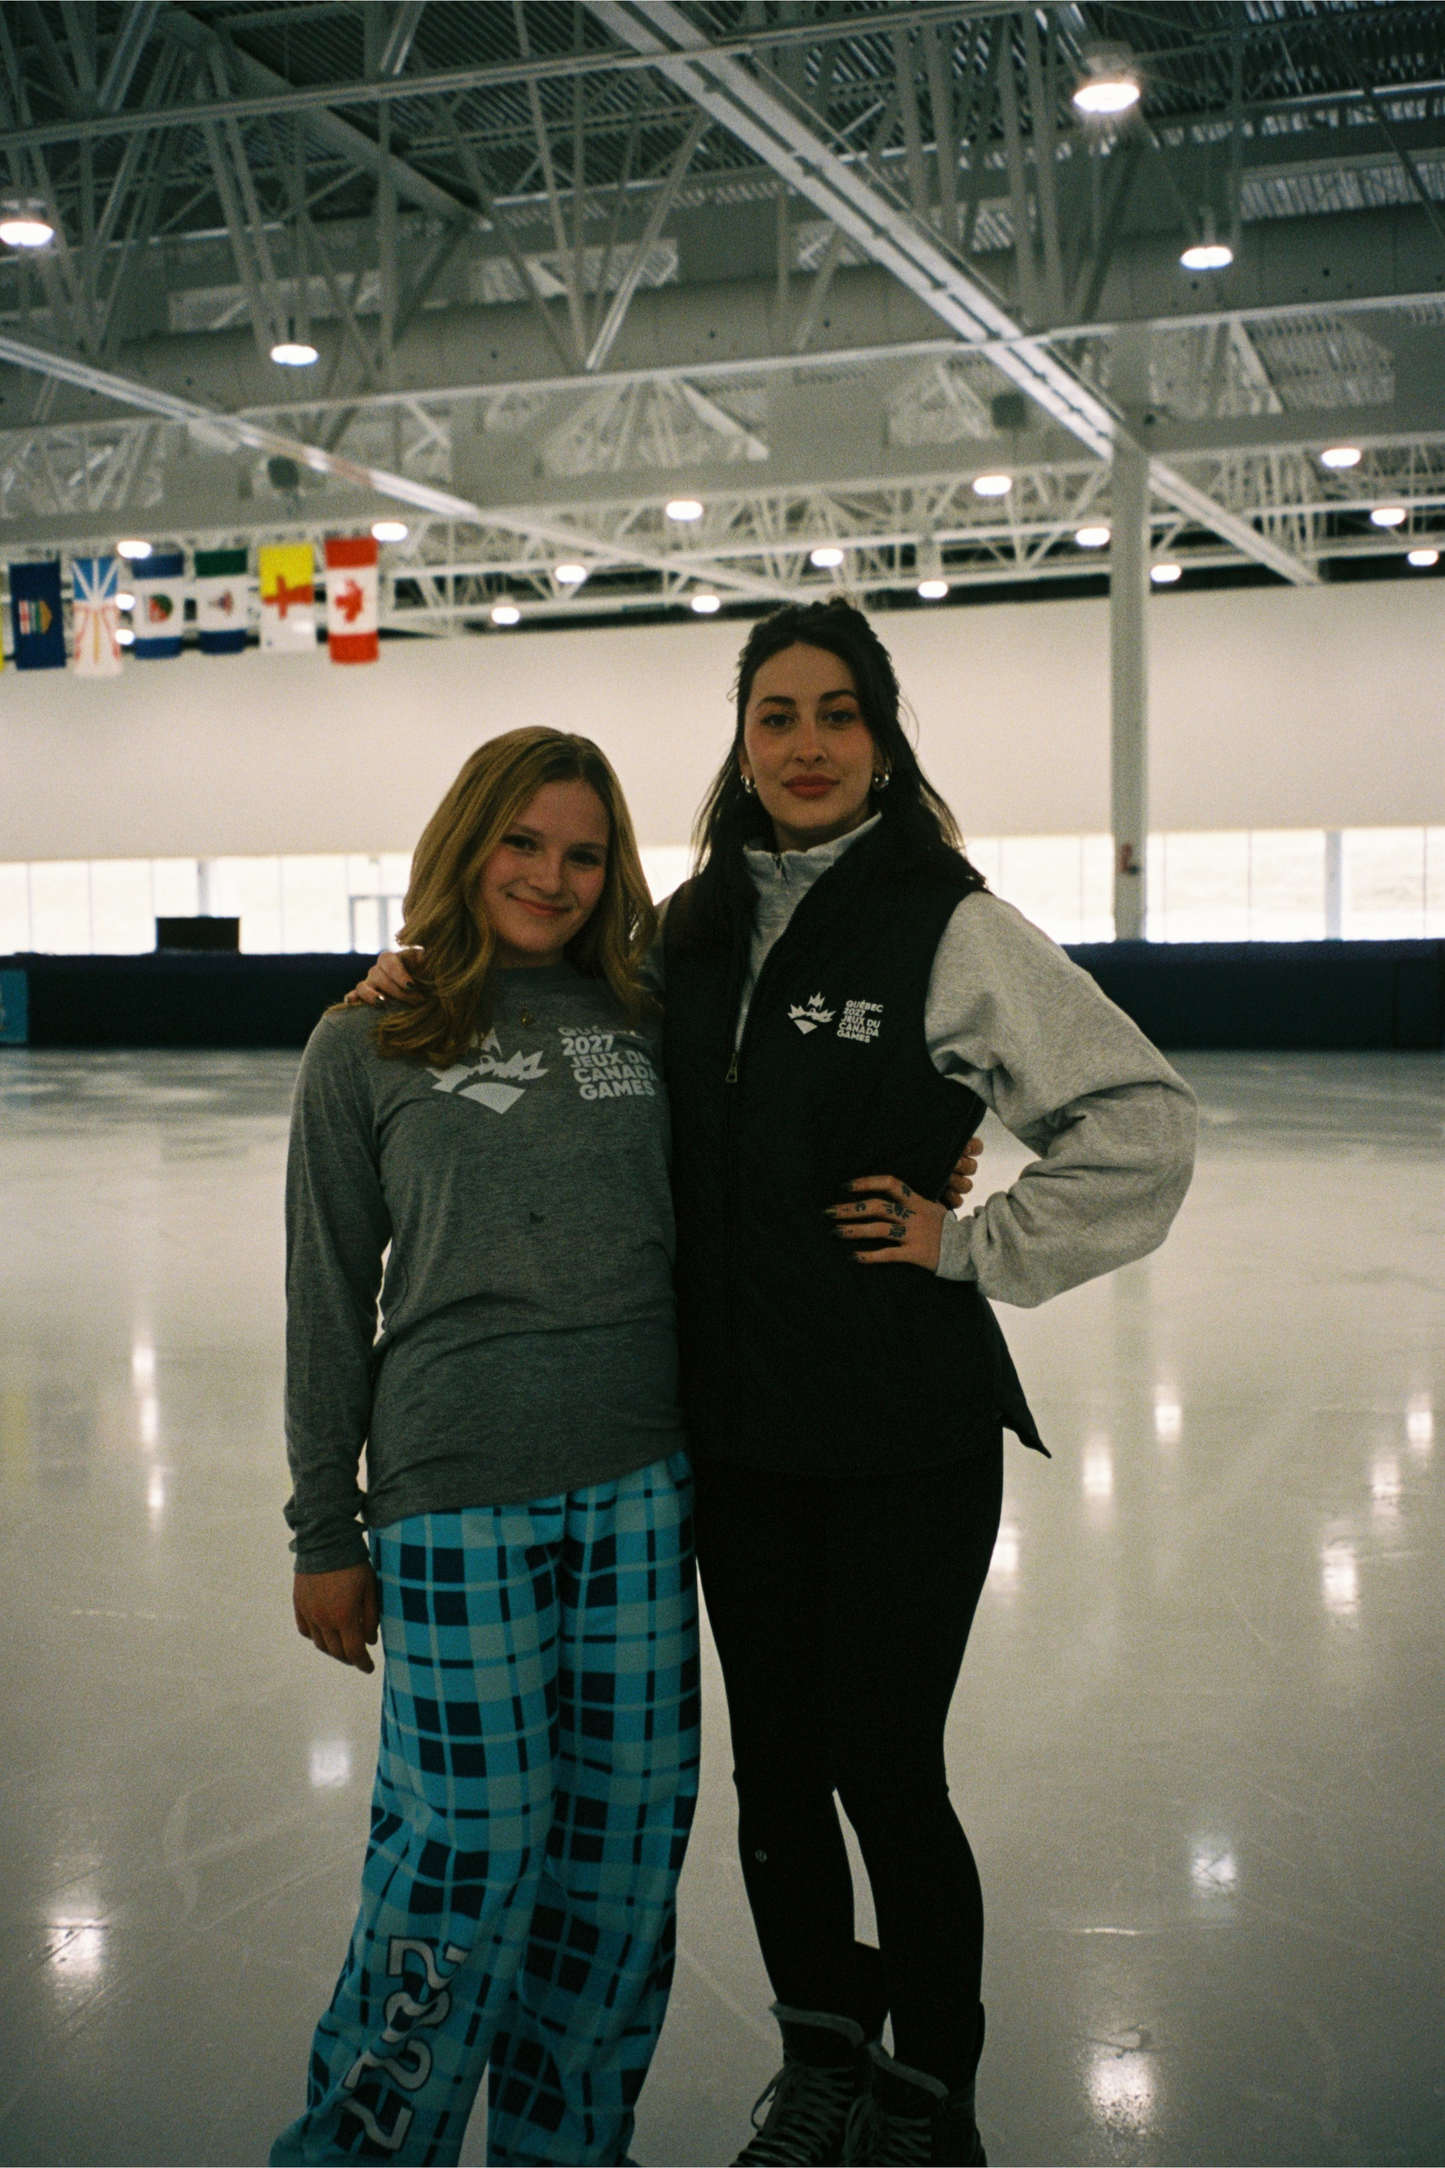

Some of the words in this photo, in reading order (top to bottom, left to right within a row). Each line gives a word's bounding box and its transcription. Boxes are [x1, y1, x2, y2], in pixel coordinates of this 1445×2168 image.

[843, 1007, 866, 1018] 2027
[845, 999, 884, 1013] QUÉBEC
[838, 1022, 879, 1037] CANADA
[840, 1015, 866, 1025] JEUX
[866, 1018, 881, 1029] DU
[836, 1029, 871, 1043] GAMES
[561, 1034, 614, 1056] 2027
[570, 1052, 624, 1068] JEUX
[573, 1065, 660, 1084] CANADA
[579, 1079, 656, 1101] GAMES
